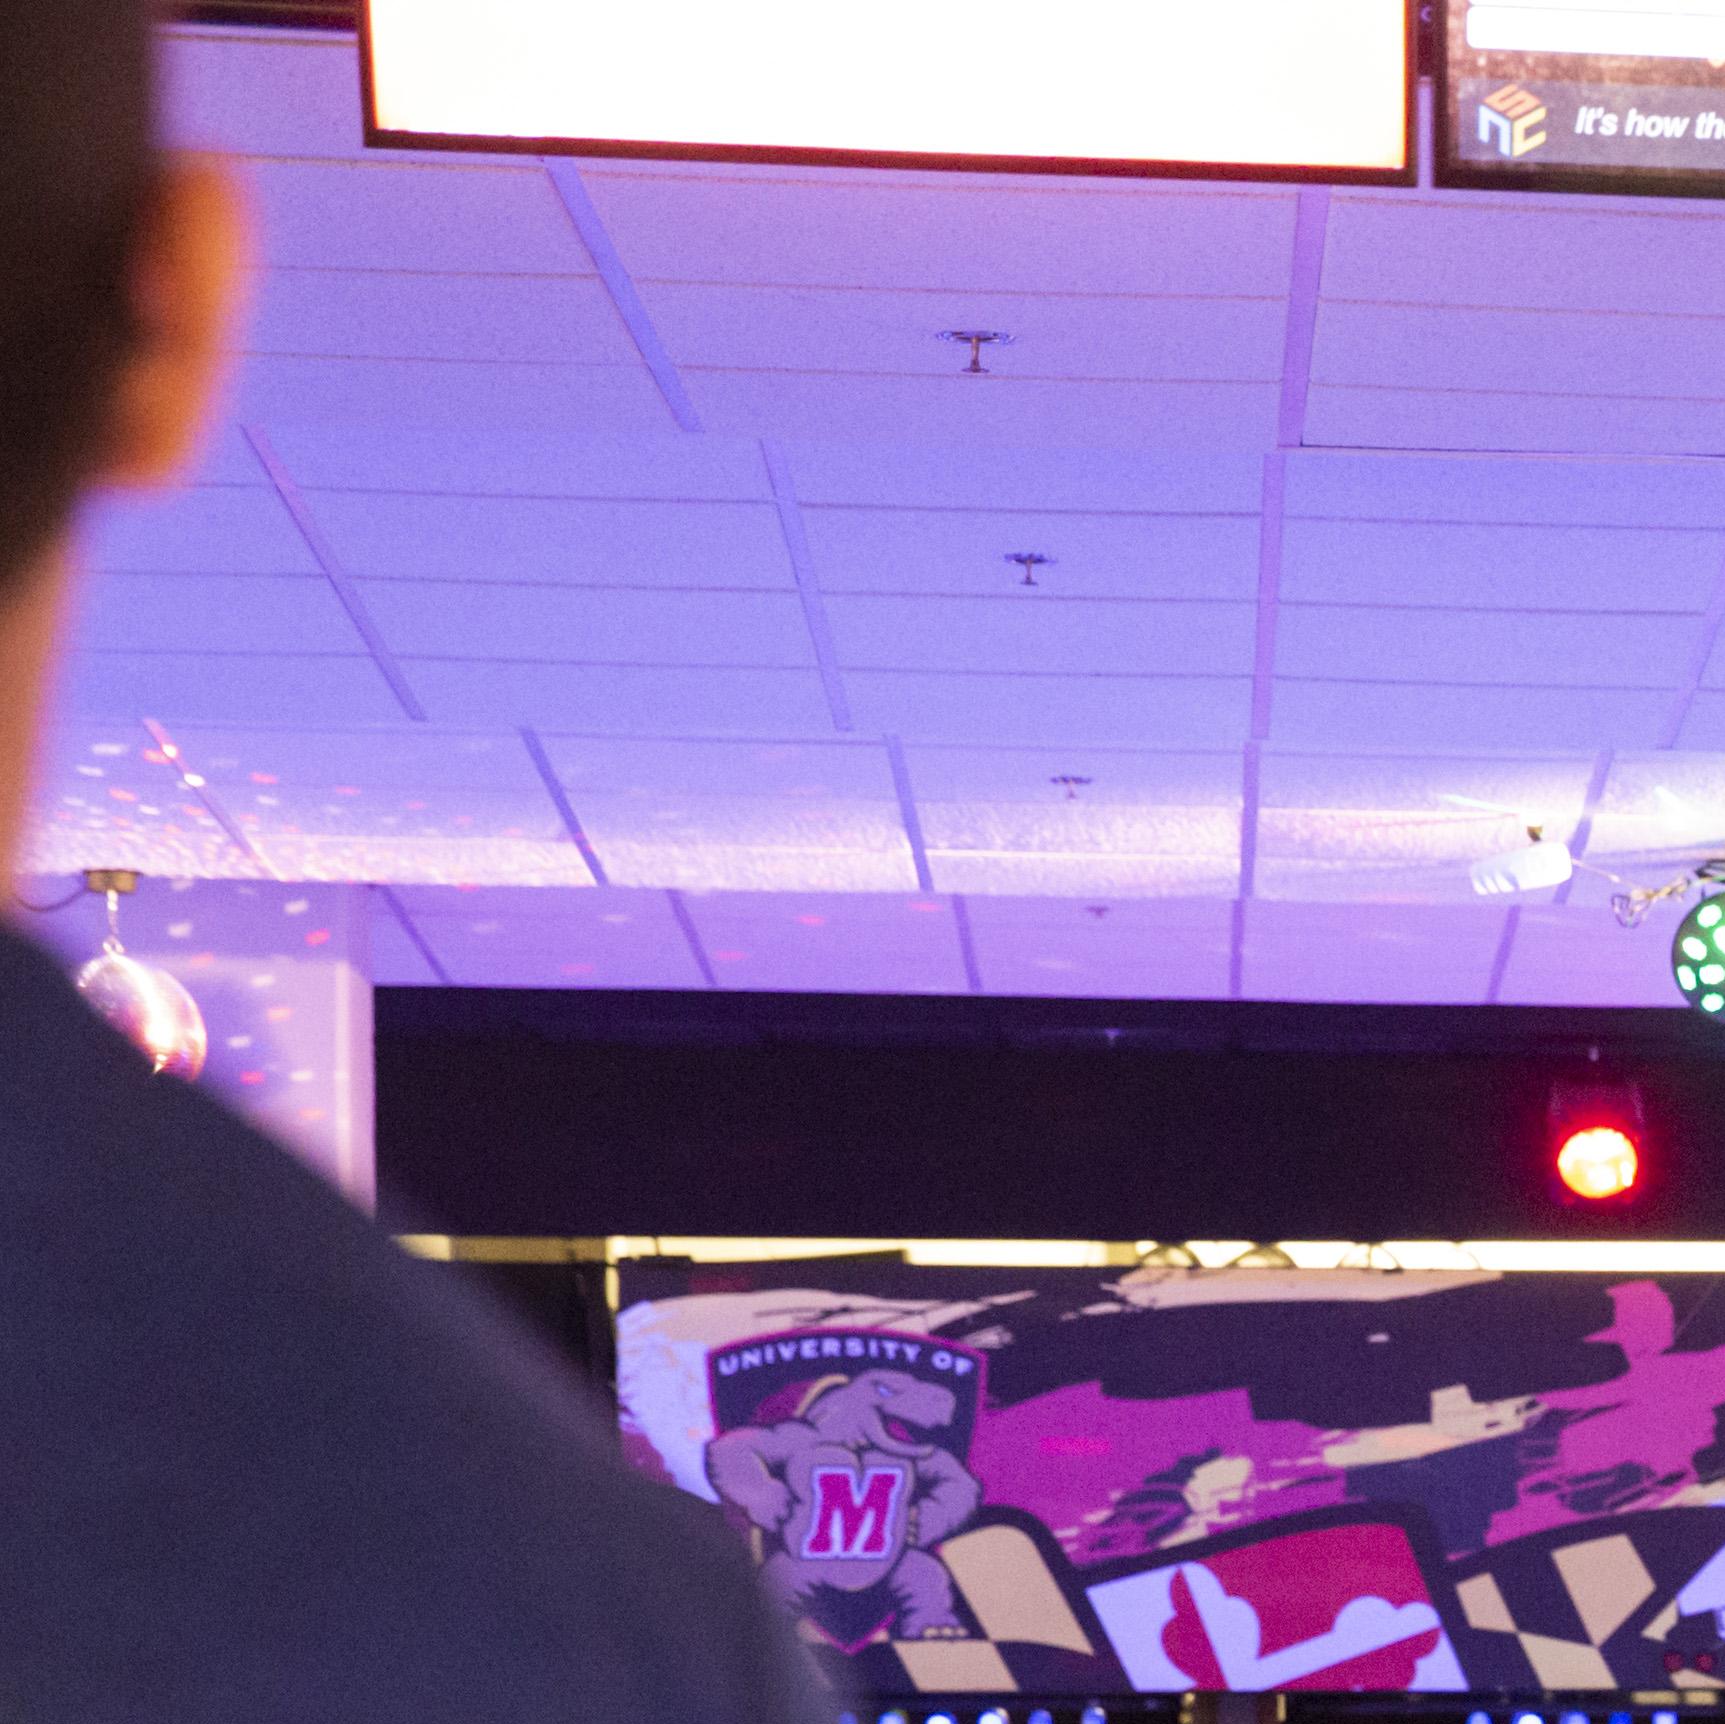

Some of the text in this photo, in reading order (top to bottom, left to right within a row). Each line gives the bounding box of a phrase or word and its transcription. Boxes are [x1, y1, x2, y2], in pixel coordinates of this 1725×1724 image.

[1575, 106, 1619, 136] It's
[1625, 109, 1689, 139] how
[718, 1336, 974, 1376] UNIVERSITY OF
[803, 1466, 900, 1560] M
